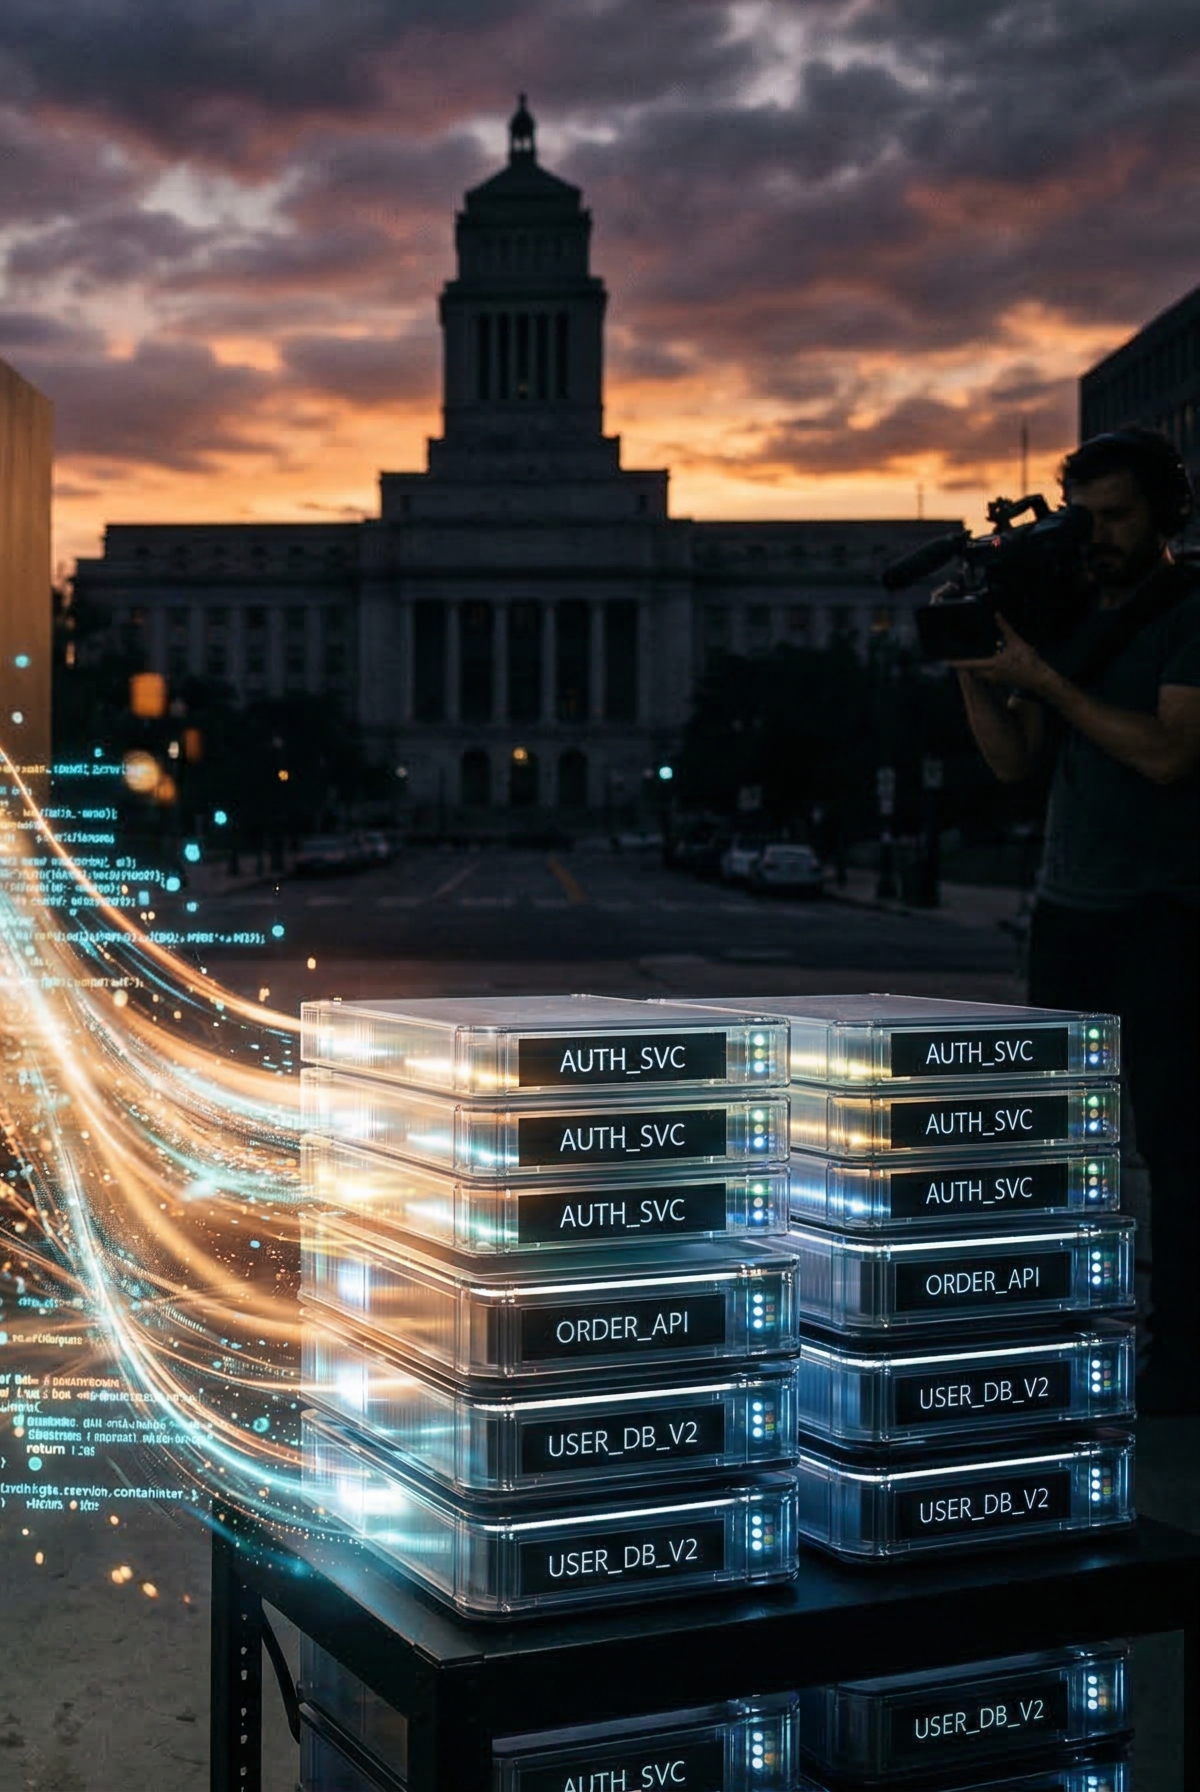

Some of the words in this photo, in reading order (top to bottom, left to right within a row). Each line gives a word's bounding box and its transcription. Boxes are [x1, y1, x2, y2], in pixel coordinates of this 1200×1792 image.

[560, 1046, 686, 1075] AUTH_SVC
[926, 1041, 1033, 1066] AUTH_SVC
[560, 1122, 686, 1152] AUTH_SVC
[926, 1109, 1033, 1136] AUTH_SVC
[926, 1177, 1033, 1205] AUTH_SVC
[560, 1198, 686, 1228] AUTH_SVC
[926, 1267, 1039, 1296] ORDER_API
[556, 1312, 688, 1343] ORDER_API
[920, 1377, 1049, 1409] USER_DB_V2
[26, 1443, 65, 1455] return
[549, 1421, 698, 1457] USER_DB_V2
[920, 1488, 1049, 1523] USER_DB_V2
[549, 1538, 698, 1577] USER_DB_V2
[915, 1700, 1044, 1735] USER_DB_V2
